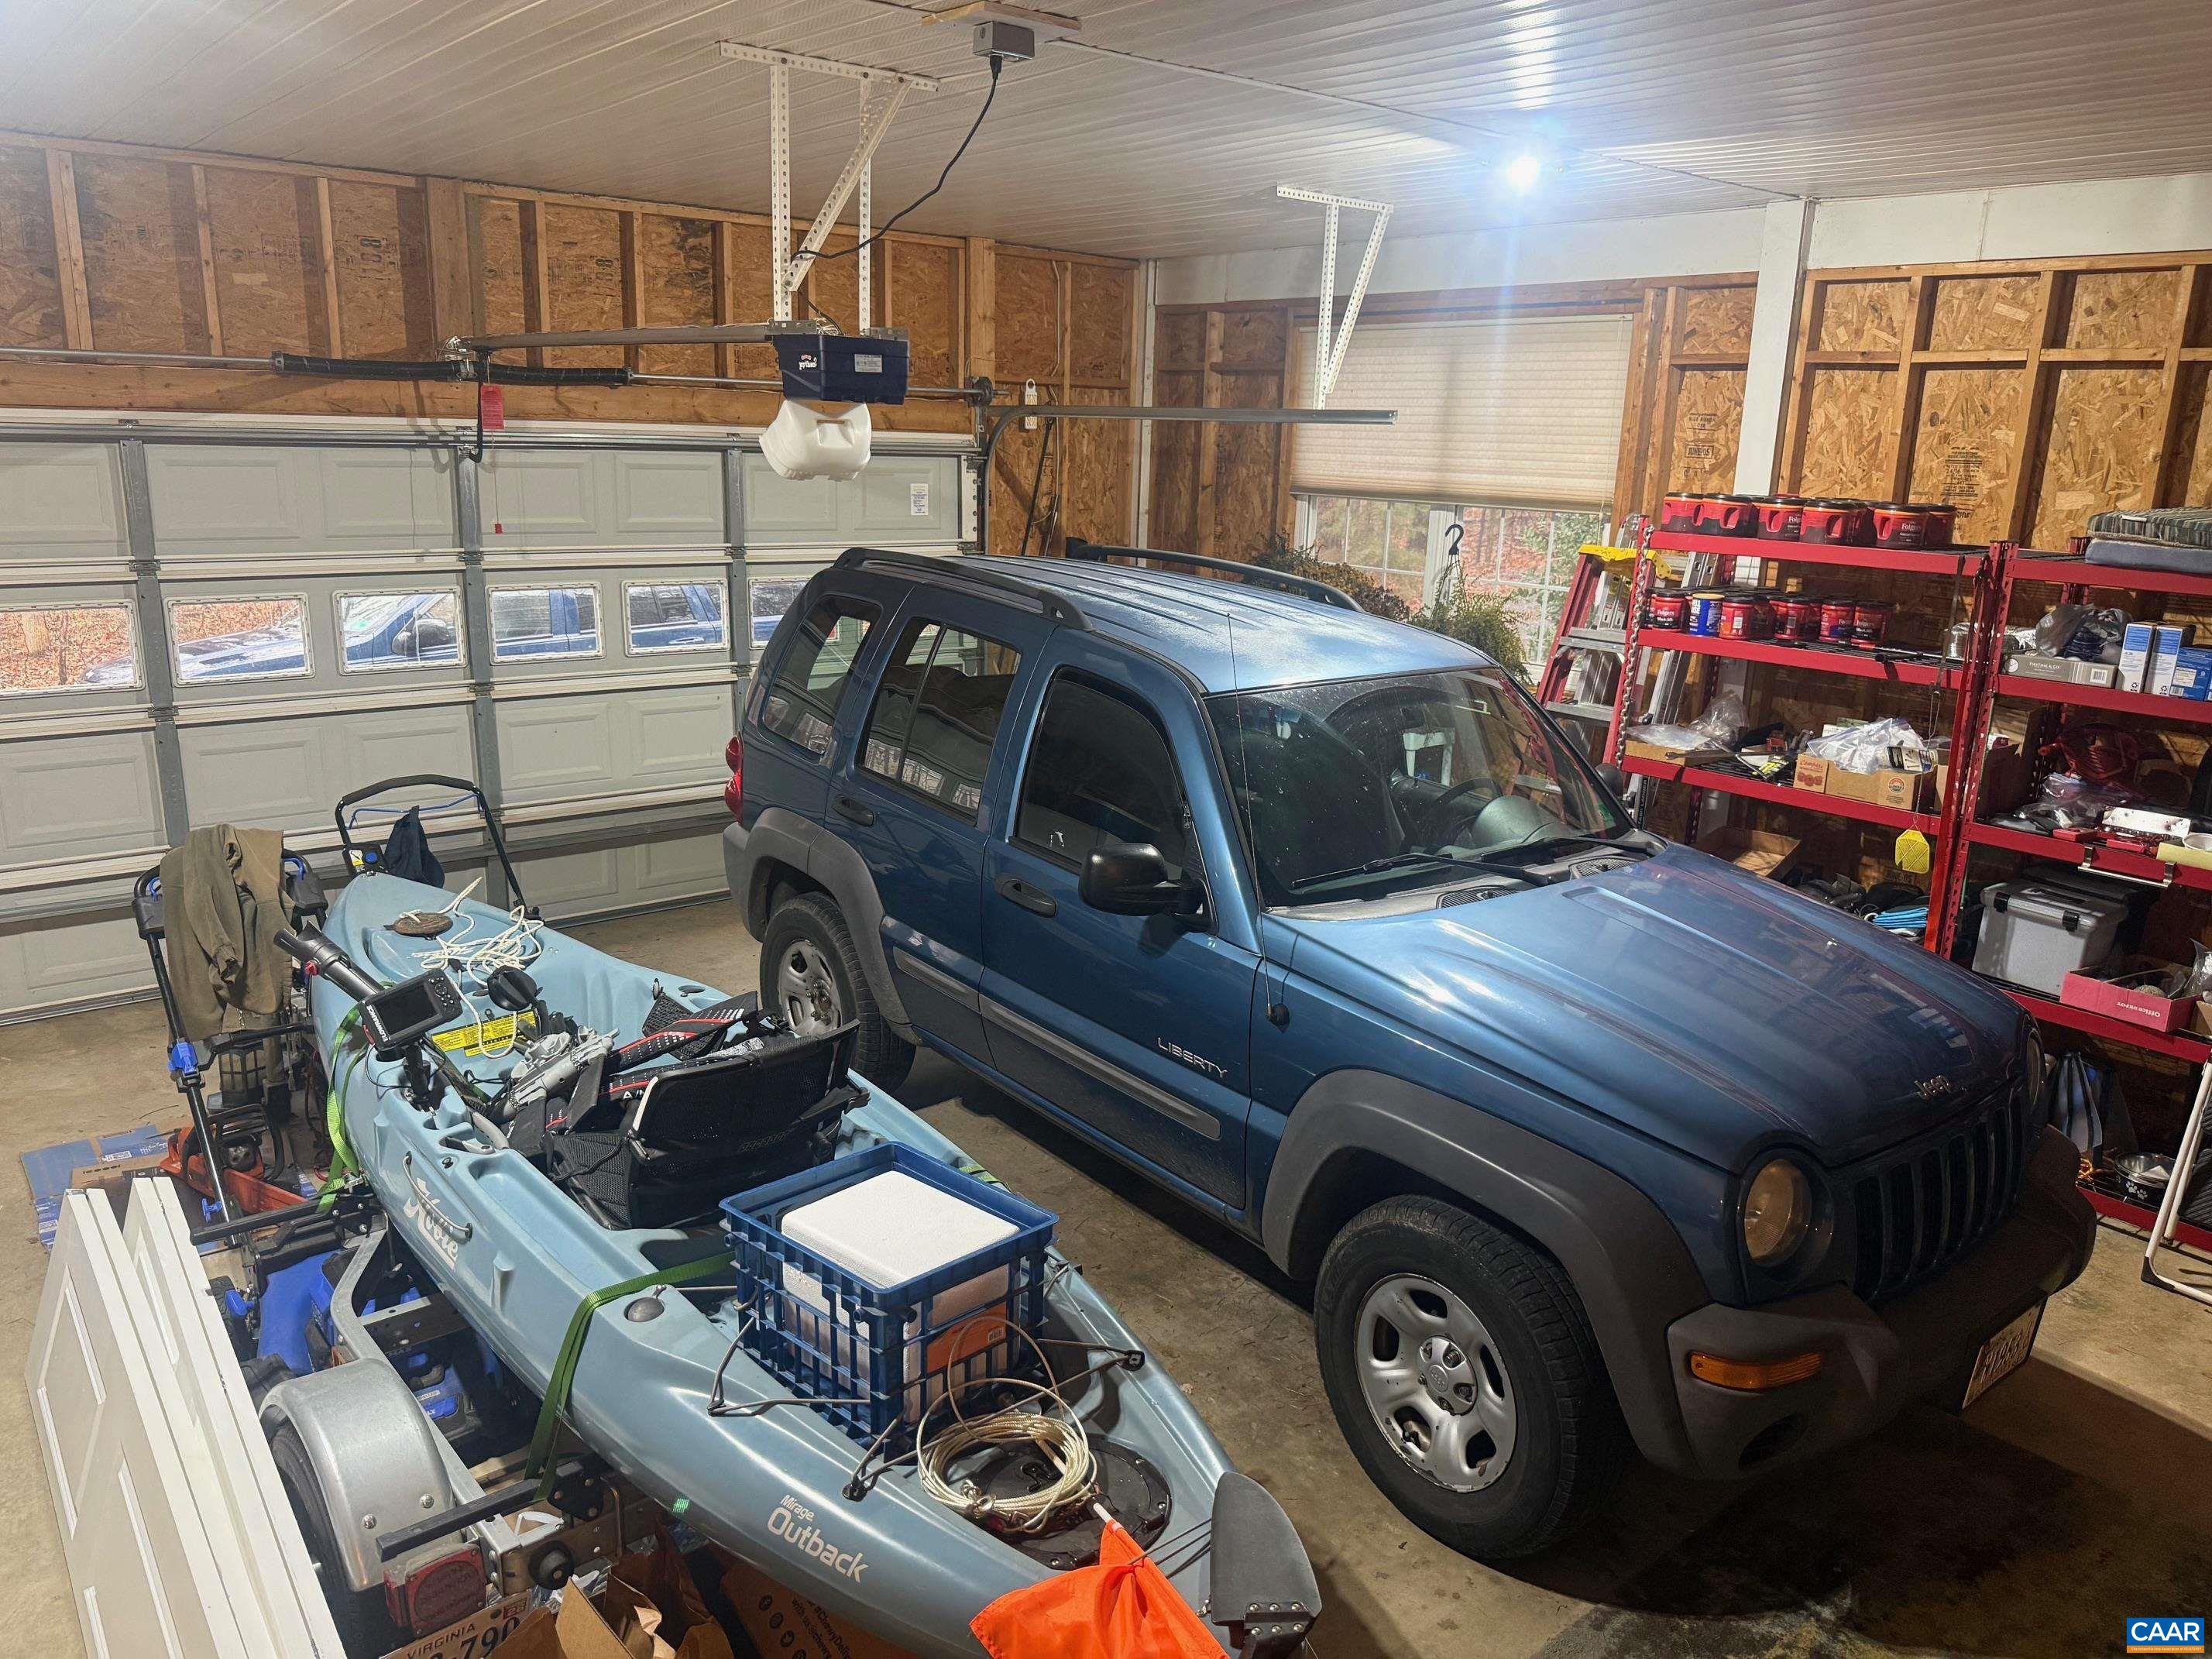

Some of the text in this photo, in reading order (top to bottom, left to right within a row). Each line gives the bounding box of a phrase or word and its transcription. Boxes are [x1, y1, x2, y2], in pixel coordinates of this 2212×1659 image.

[1657, 608, 1674, 617] Folgers
[366, 1005, 387, 1038] LOWRANCE
[2138, 1007, 2161, 1017] Office
[1157, 1036, 1228, 1078] LIBERTY
[1914, 1074, 1949, 1100] Jeep
[780, 1494, 815, 1522] Mirage
[768, 1506, 869, 1583] Outback
[407, 1623, 476, 1659] VIRGINIA
